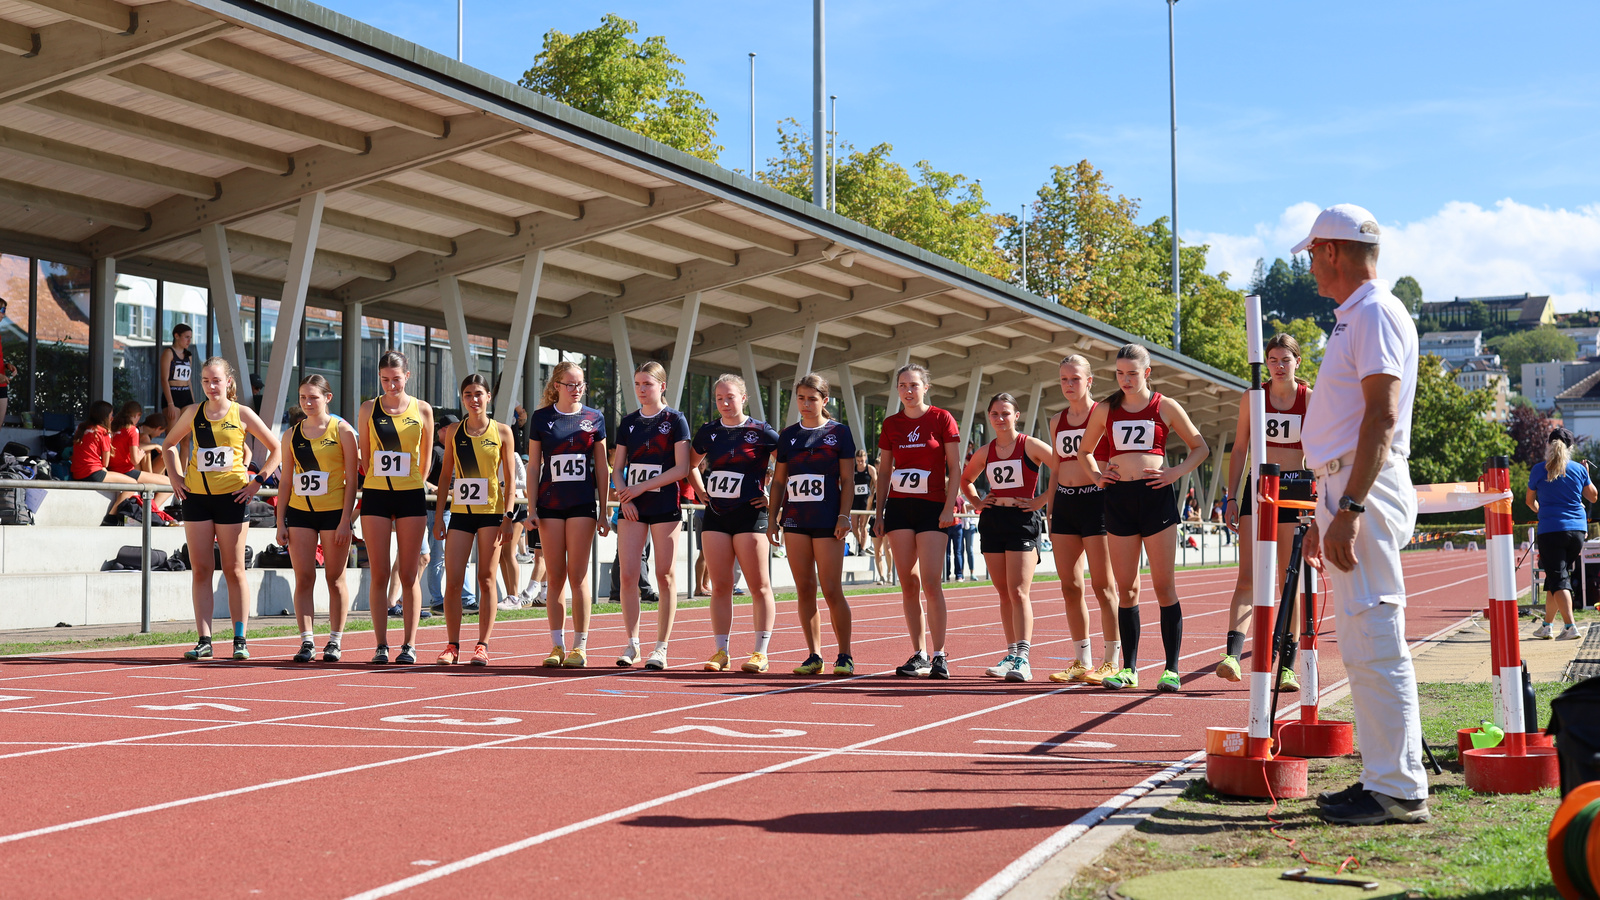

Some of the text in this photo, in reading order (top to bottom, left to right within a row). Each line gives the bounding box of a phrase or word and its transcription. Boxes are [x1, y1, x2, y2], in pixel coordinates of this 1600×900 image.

[177, 368, 190, 378] 141
[1121, 426, 1146, 444] 72
[1266, 419, 1290, 438] 81
[1062, 435, 1083, 454] 80
[204, 451, 226, 467] 94
[381, 455, 401, 472] 91
[552, 459, 584, 476] 145
[300, 475, 320, 491] 95
[899, 472, 920, 488] 79
[993, 466, 1015, 484] 82
[459, 483, 480, 500] 92
[710, 476, 741, 493] 147
[789, 479, 822, 496] 148
[1057, 486, 1075, 495] PRO
[1222, 738, 1244, 747] KIDS
